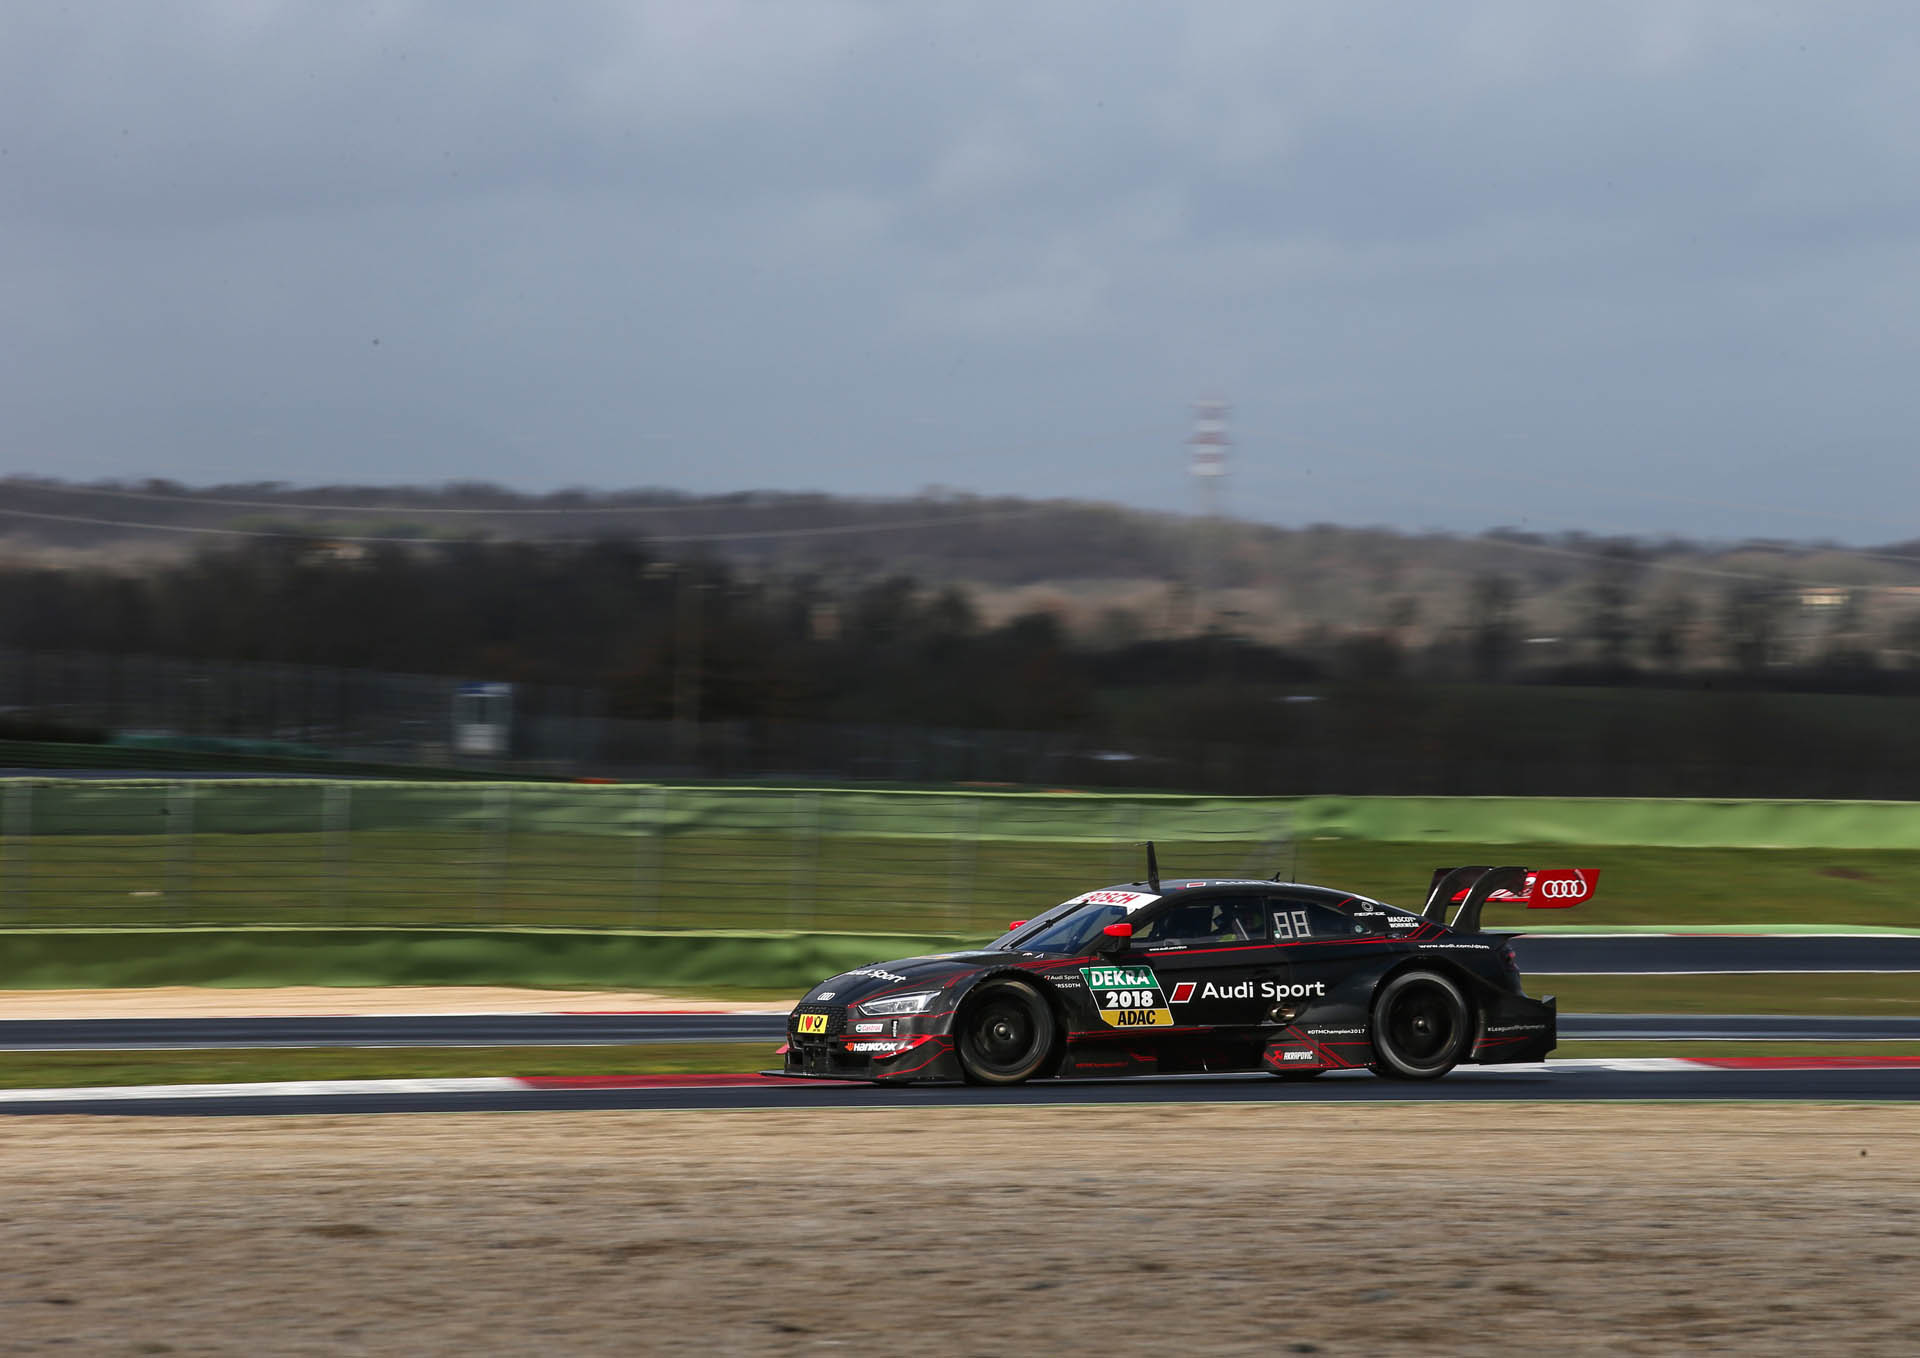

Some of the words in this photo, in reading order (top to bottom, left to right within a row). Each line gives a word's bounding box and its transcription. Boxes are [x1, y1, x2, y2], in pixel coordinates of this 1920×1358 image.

[1092, 969, 1151, 987] DEKRA
[1106, 990, 1154, 1008] 2018
[1201, 981, 1255, 999] Audi
[1261, 980, 1326, 1002] Sport
[1117, 1010, 1156, 1025] ADAC
